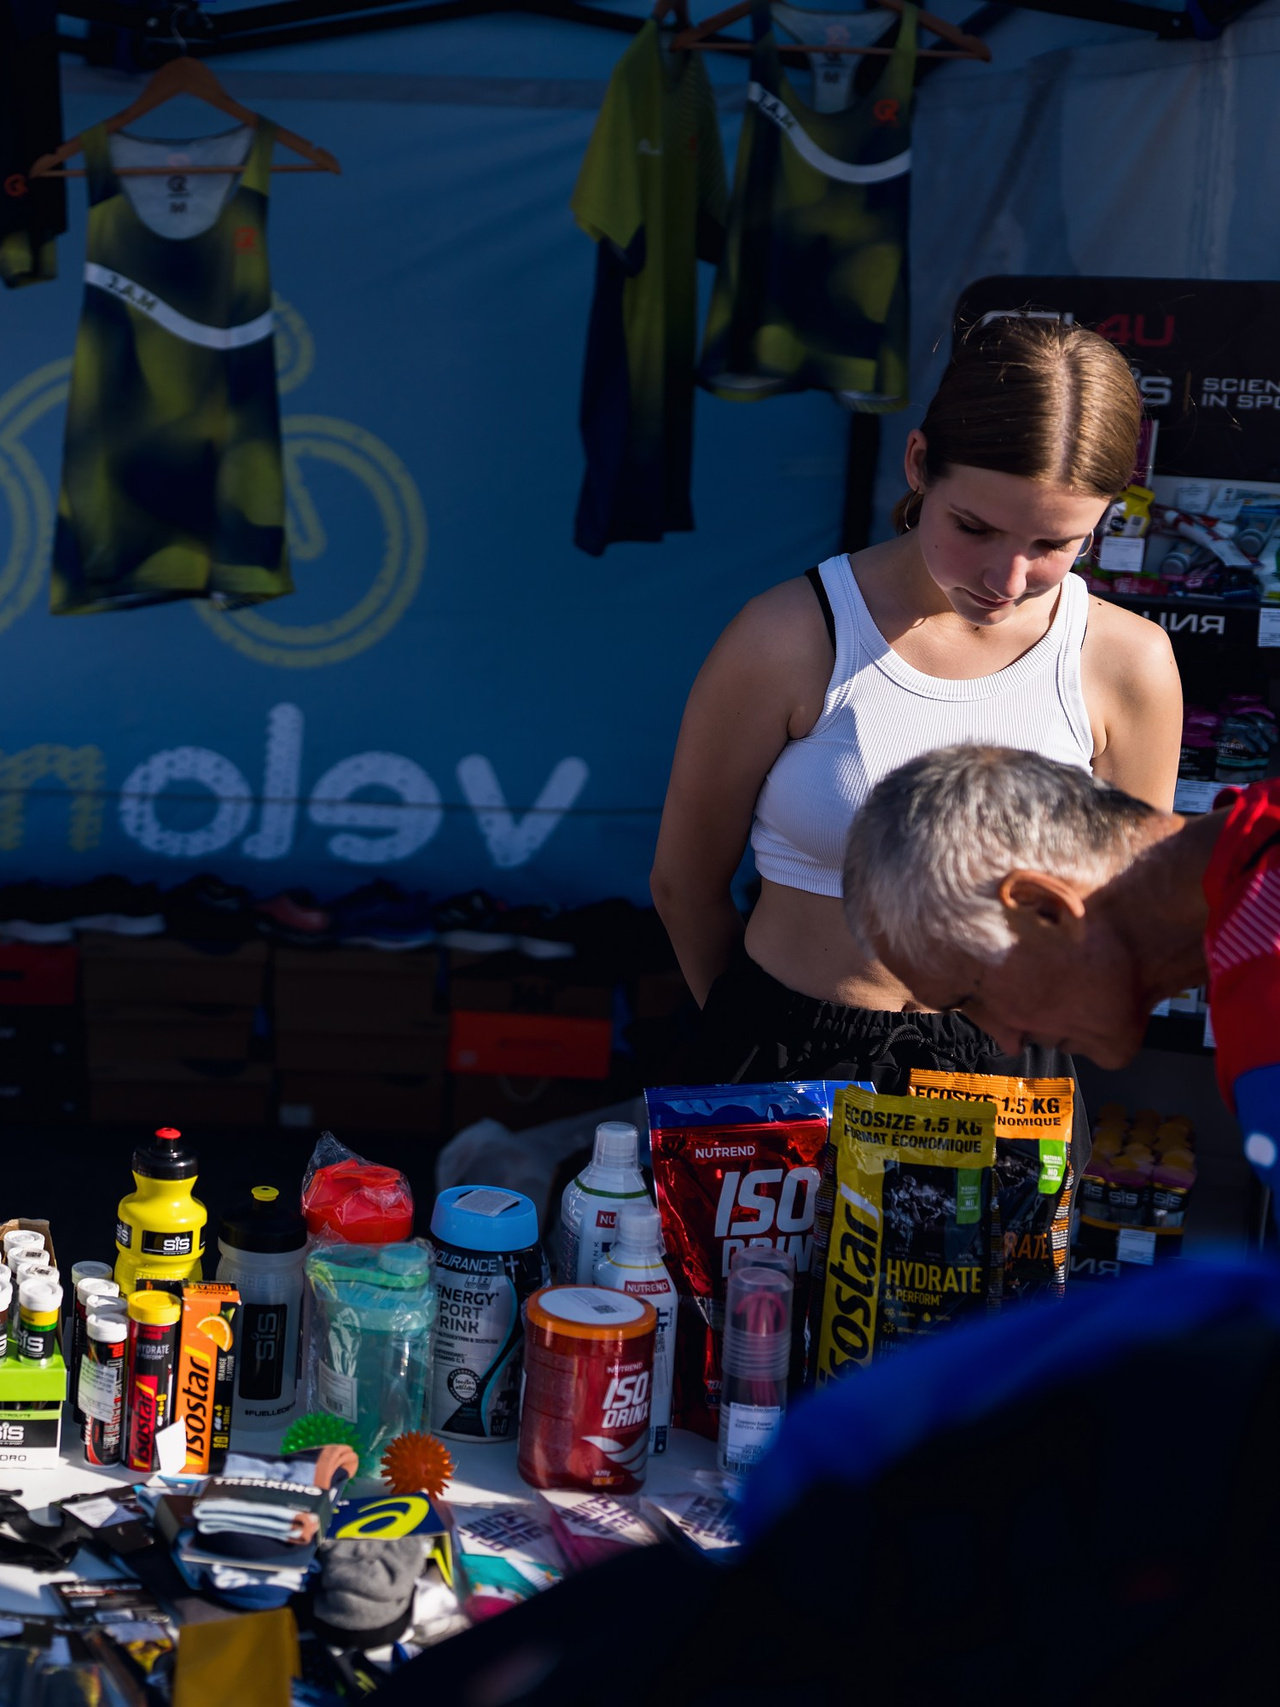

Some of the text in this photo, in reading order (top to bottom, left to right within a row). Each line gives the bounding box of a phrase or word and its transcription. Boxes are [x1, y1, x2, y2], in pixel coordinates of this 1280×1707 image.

[1202, 394, 1228, 408] IN
[1001, 1097, 1026, 1114] 1.5
[1034, 1098, 1060, 1114] KG
[845, 1104, 981, 1136] ECOSIZE 1.5 KG
[997, 1117, 1062, 1126] NOMIQUE
[695, 1145, 756, 1158] NUTREND
[891, 1130, 981, 1156] ÉCONOMIQUE
[714, 1167, 821, 1238] ISO
[163, 1236, 190, 1251] SiS
[1003, 1231, 1050, 1258] RATE
[434, 1247, 498, 1272] NDURANCE
[886, 1259, 983, 1294] HYDRATE
[627, 1283, 669, 1293] NUTREND
[439, 1302, 483, 1319] PORT
[250, 1312, 277, 1361] SiS
[439, 1319, 480, 1334] RINK
[217, 1357, 227, 1381] ORANGE
[606, 1362, 643, 1374] NUTREND
[602, 1371, 650, 1411] ISO
[182, 1356, 210, 1460] isostar
[214, 1477, 323, 1496] TREKKING
